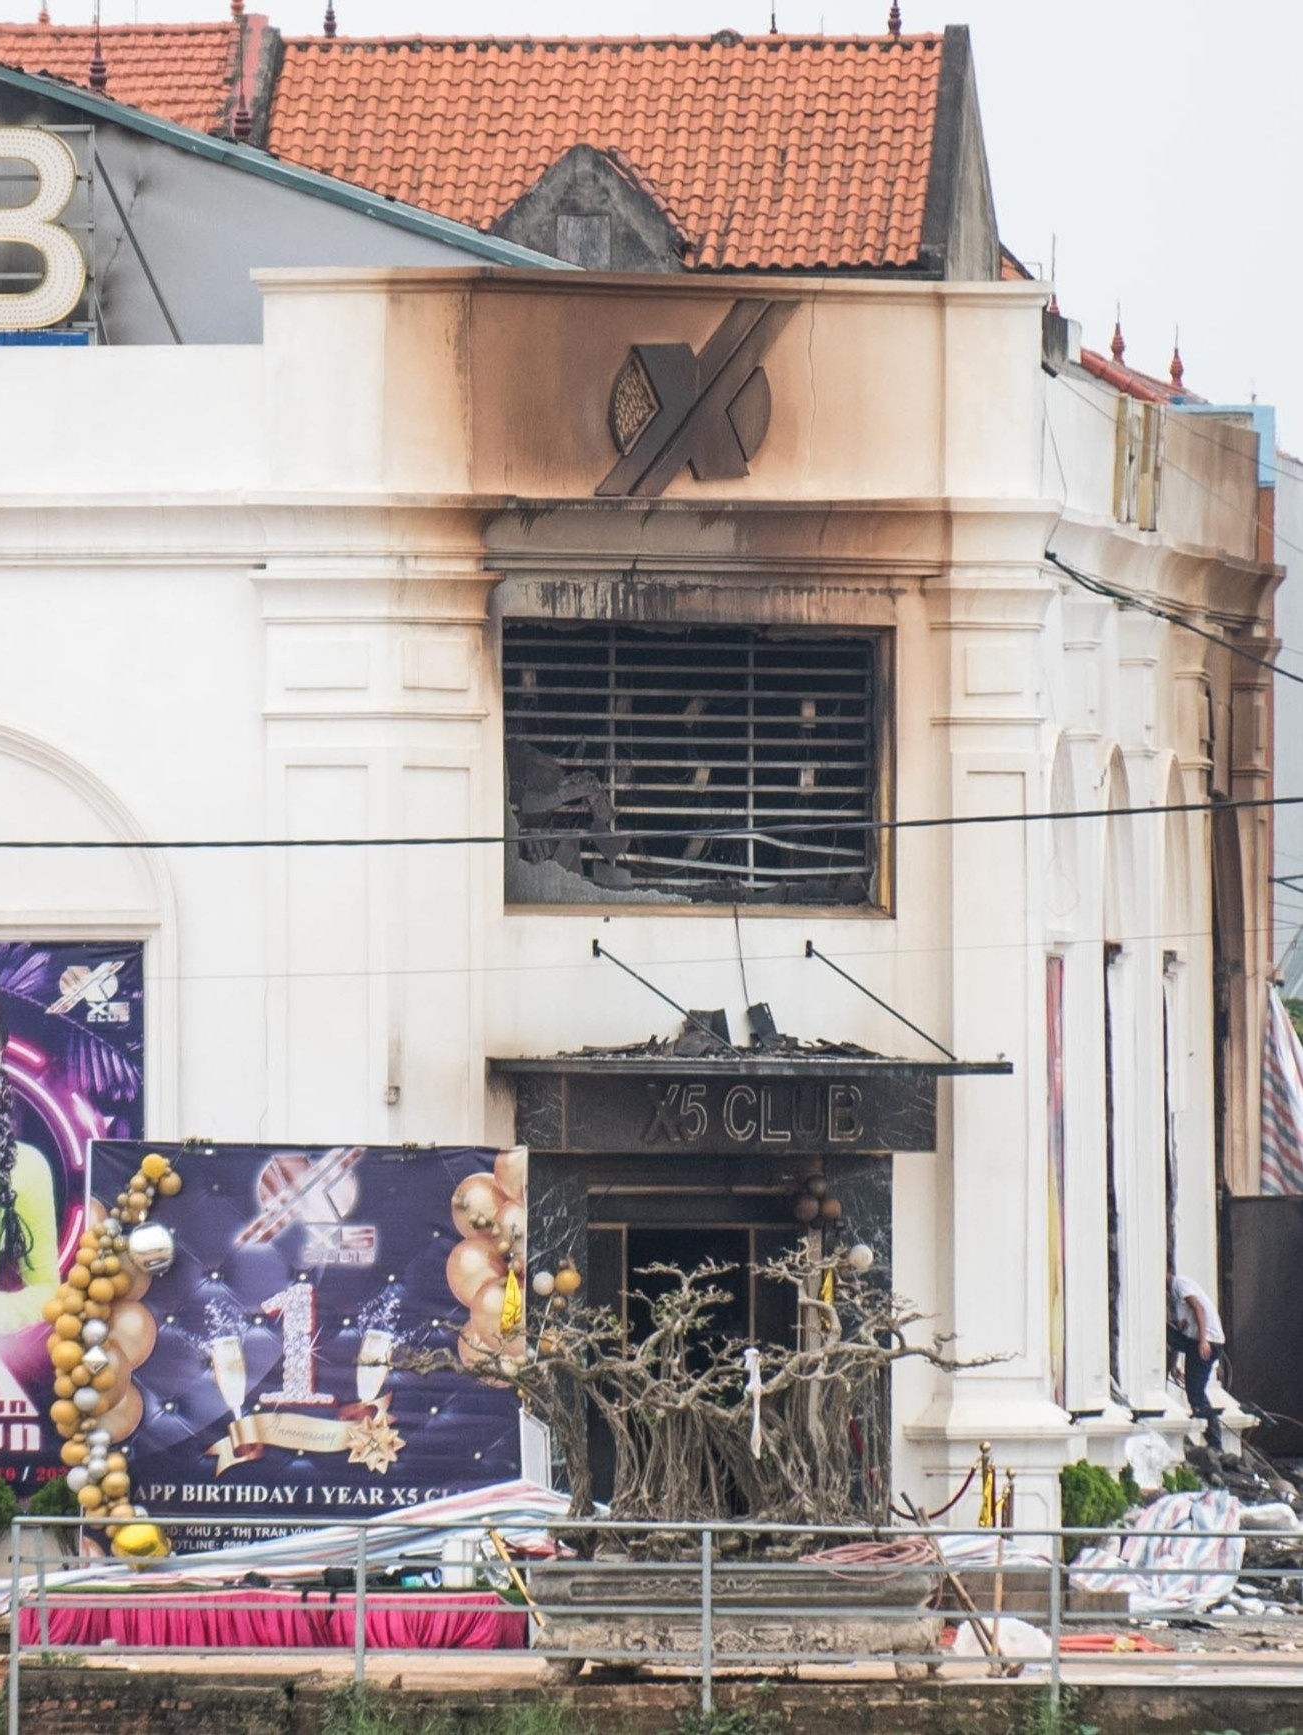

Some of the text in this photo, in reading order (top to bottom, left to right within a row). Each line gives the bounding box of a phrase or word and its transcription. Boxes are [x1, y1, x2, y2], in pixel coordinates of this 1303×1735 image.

[642, 1083, 865, 1142] X5 CLUB
[134, 1484, 177, 1501] APP
[181, 1484, 299, 1505] BIRTHDAY
[305, 1486, 314, 1504] 1
[321, 1486, 384, 1505] YEAR
[390, 1487, 419, 1506] X5
[185, 1526, 211, 1537] KHU
[172, 1540, 220, 1551] OTLINE:
